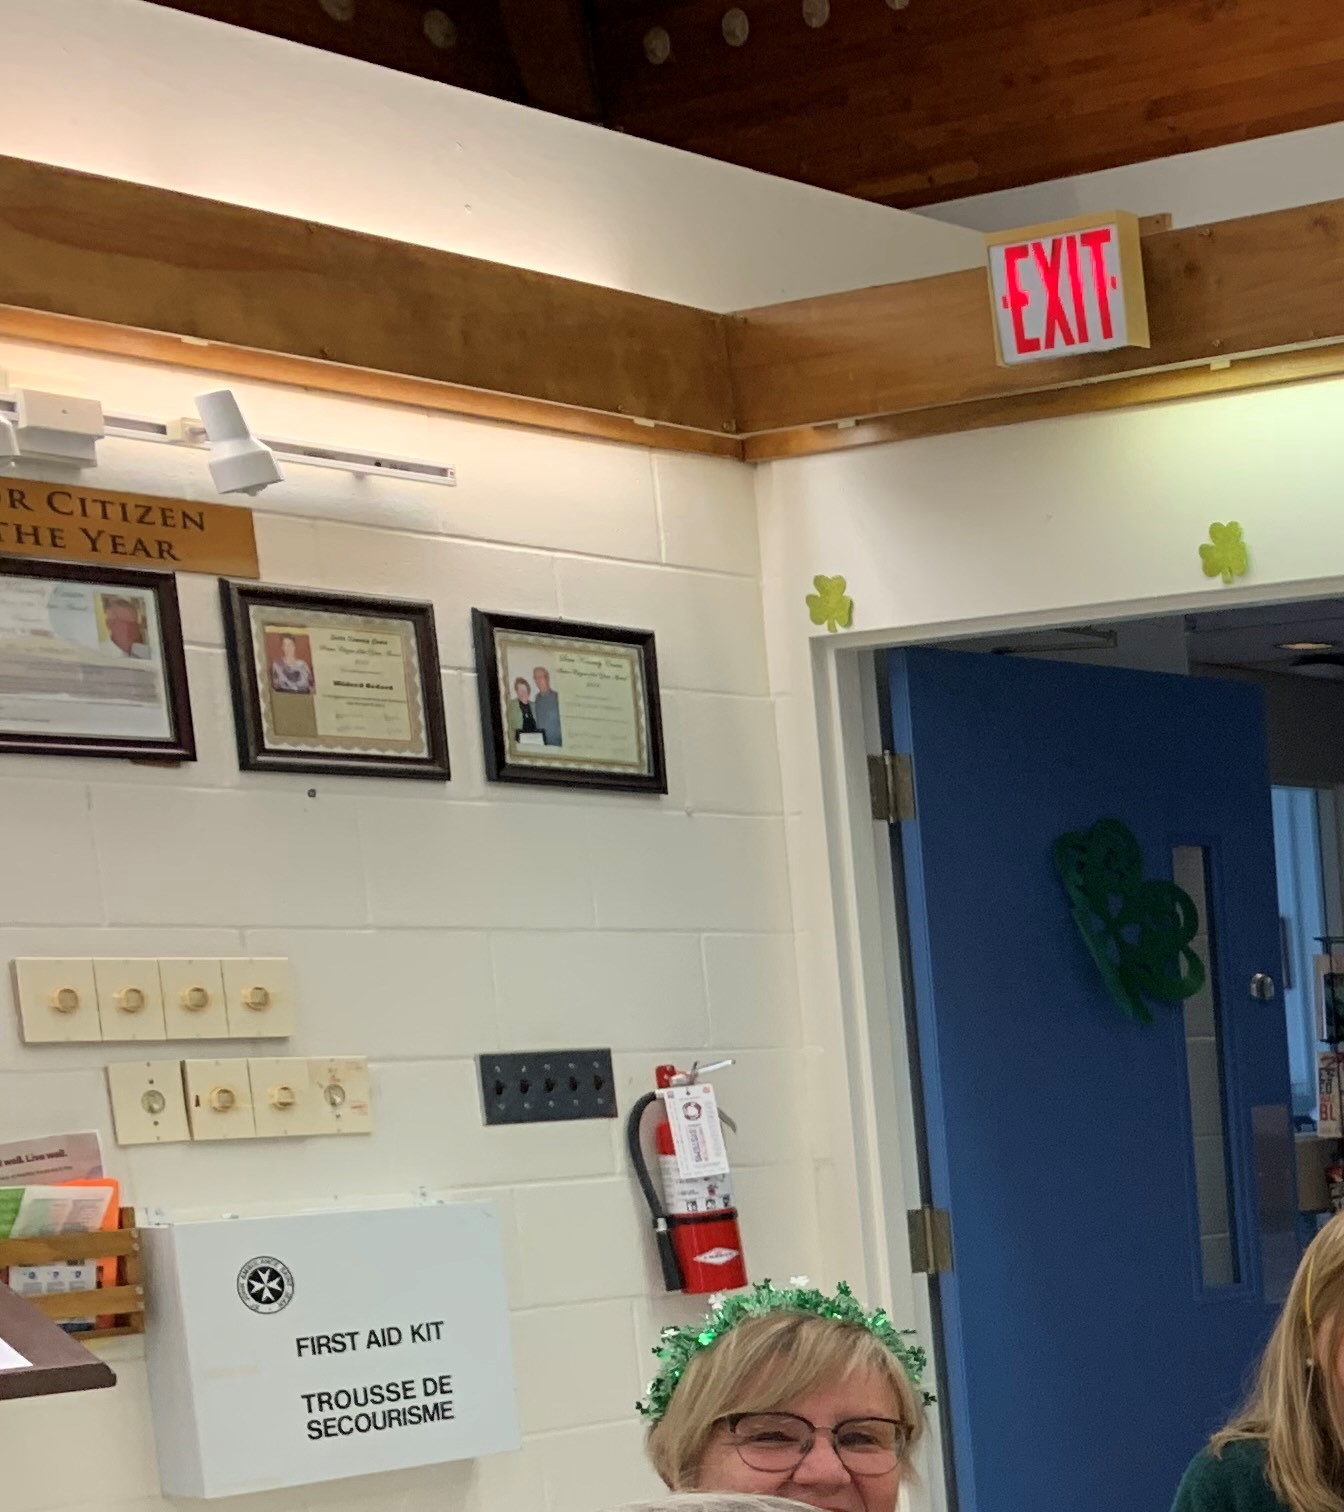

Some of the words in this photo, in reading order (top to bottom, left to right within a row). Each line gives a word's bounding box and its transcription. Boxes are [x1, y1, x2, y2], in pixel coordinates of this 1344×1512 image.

[1003, 228, 1113, 354] EXIT
[0, 488, 35, 512] R
[47, 491, 205, 532] CITIZEN
[80, 527, 182, 562] YEAR
[296, 1331, 360, 1357] FIRST
[366, 1326, 402, 1349] AID
[410, 1320, 444, 1343] KIT
[301, 1380, 416, 1414] TROUSSE
[422, 1375, 453, 1397] DE
[306, 1400, 455, 1440] SECOURISME
